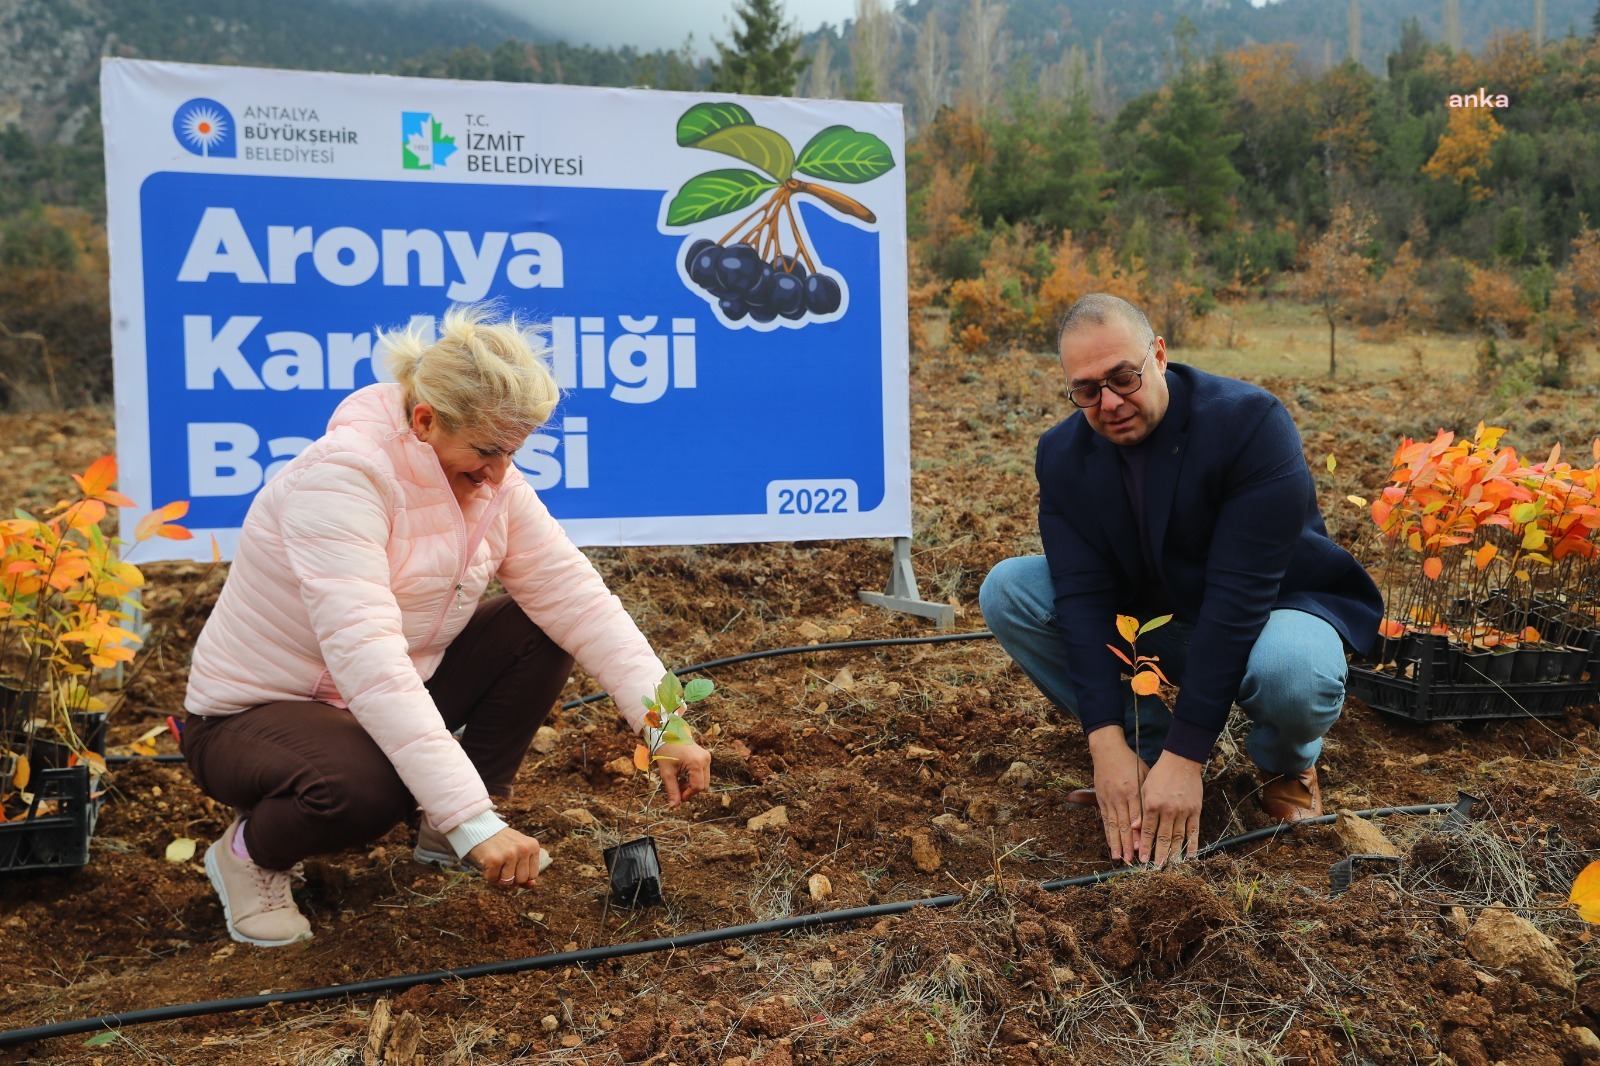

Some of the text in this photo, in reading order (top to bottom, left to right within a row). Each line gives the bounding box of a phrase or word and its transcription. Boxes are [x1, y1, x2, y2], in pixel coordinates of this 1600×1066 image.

[244, 105, 320, 122] ANTALYA
[465, 114, 489, 127] T.C.
[245, 122, 358, 146] BÜYÜKŞEHİR
[467, 129, 525, 152] İZMİT
[245, 146, 334, 164] BELEDİYESİ
[467, 153, 583, 176] BELEDİYESİ
[177, 206, 564, 302] Aronya
[183, 315, 697, 404] Karliği
[778, 488, 848, 515] 2022
